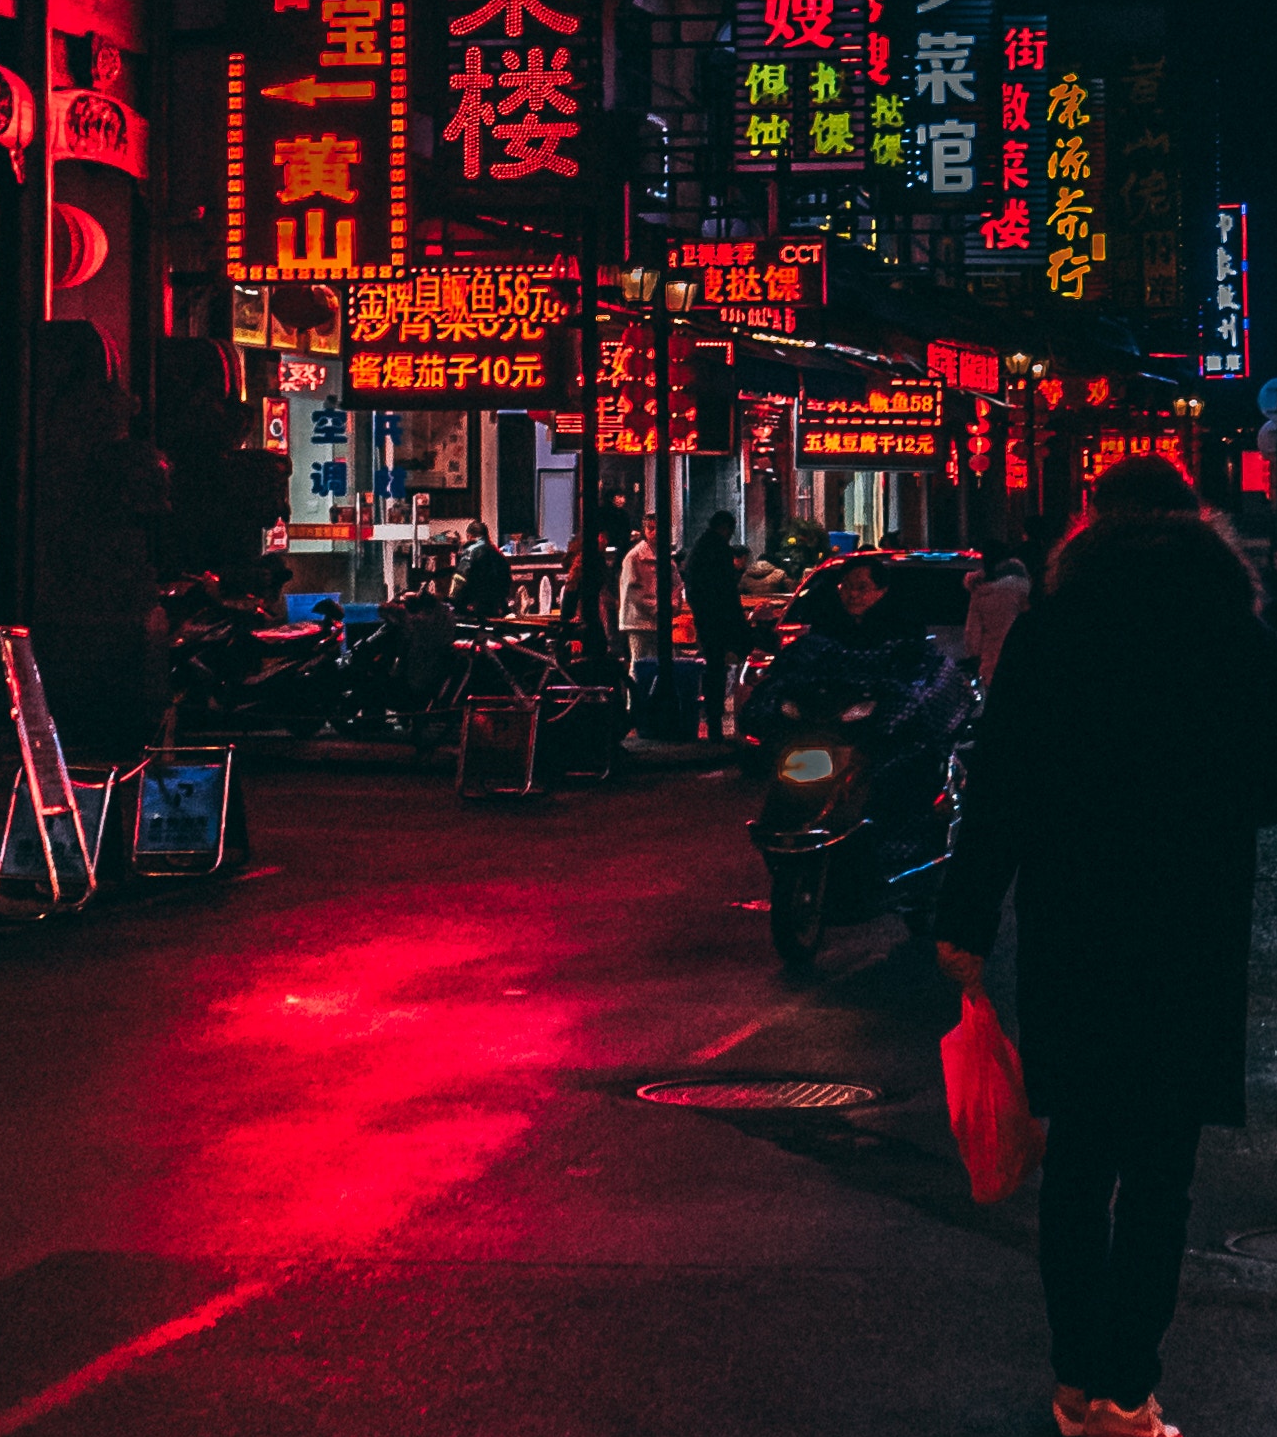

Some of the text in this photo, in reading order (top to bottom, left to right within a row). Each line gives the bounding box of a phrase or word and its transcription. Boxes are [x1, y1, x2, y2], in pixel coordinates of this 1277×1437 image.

[274, 135, 359, 269] 黄山
[349, 352, 546, 390] 酱爆茄子10元
[311, 408, 348, 497] 空调
